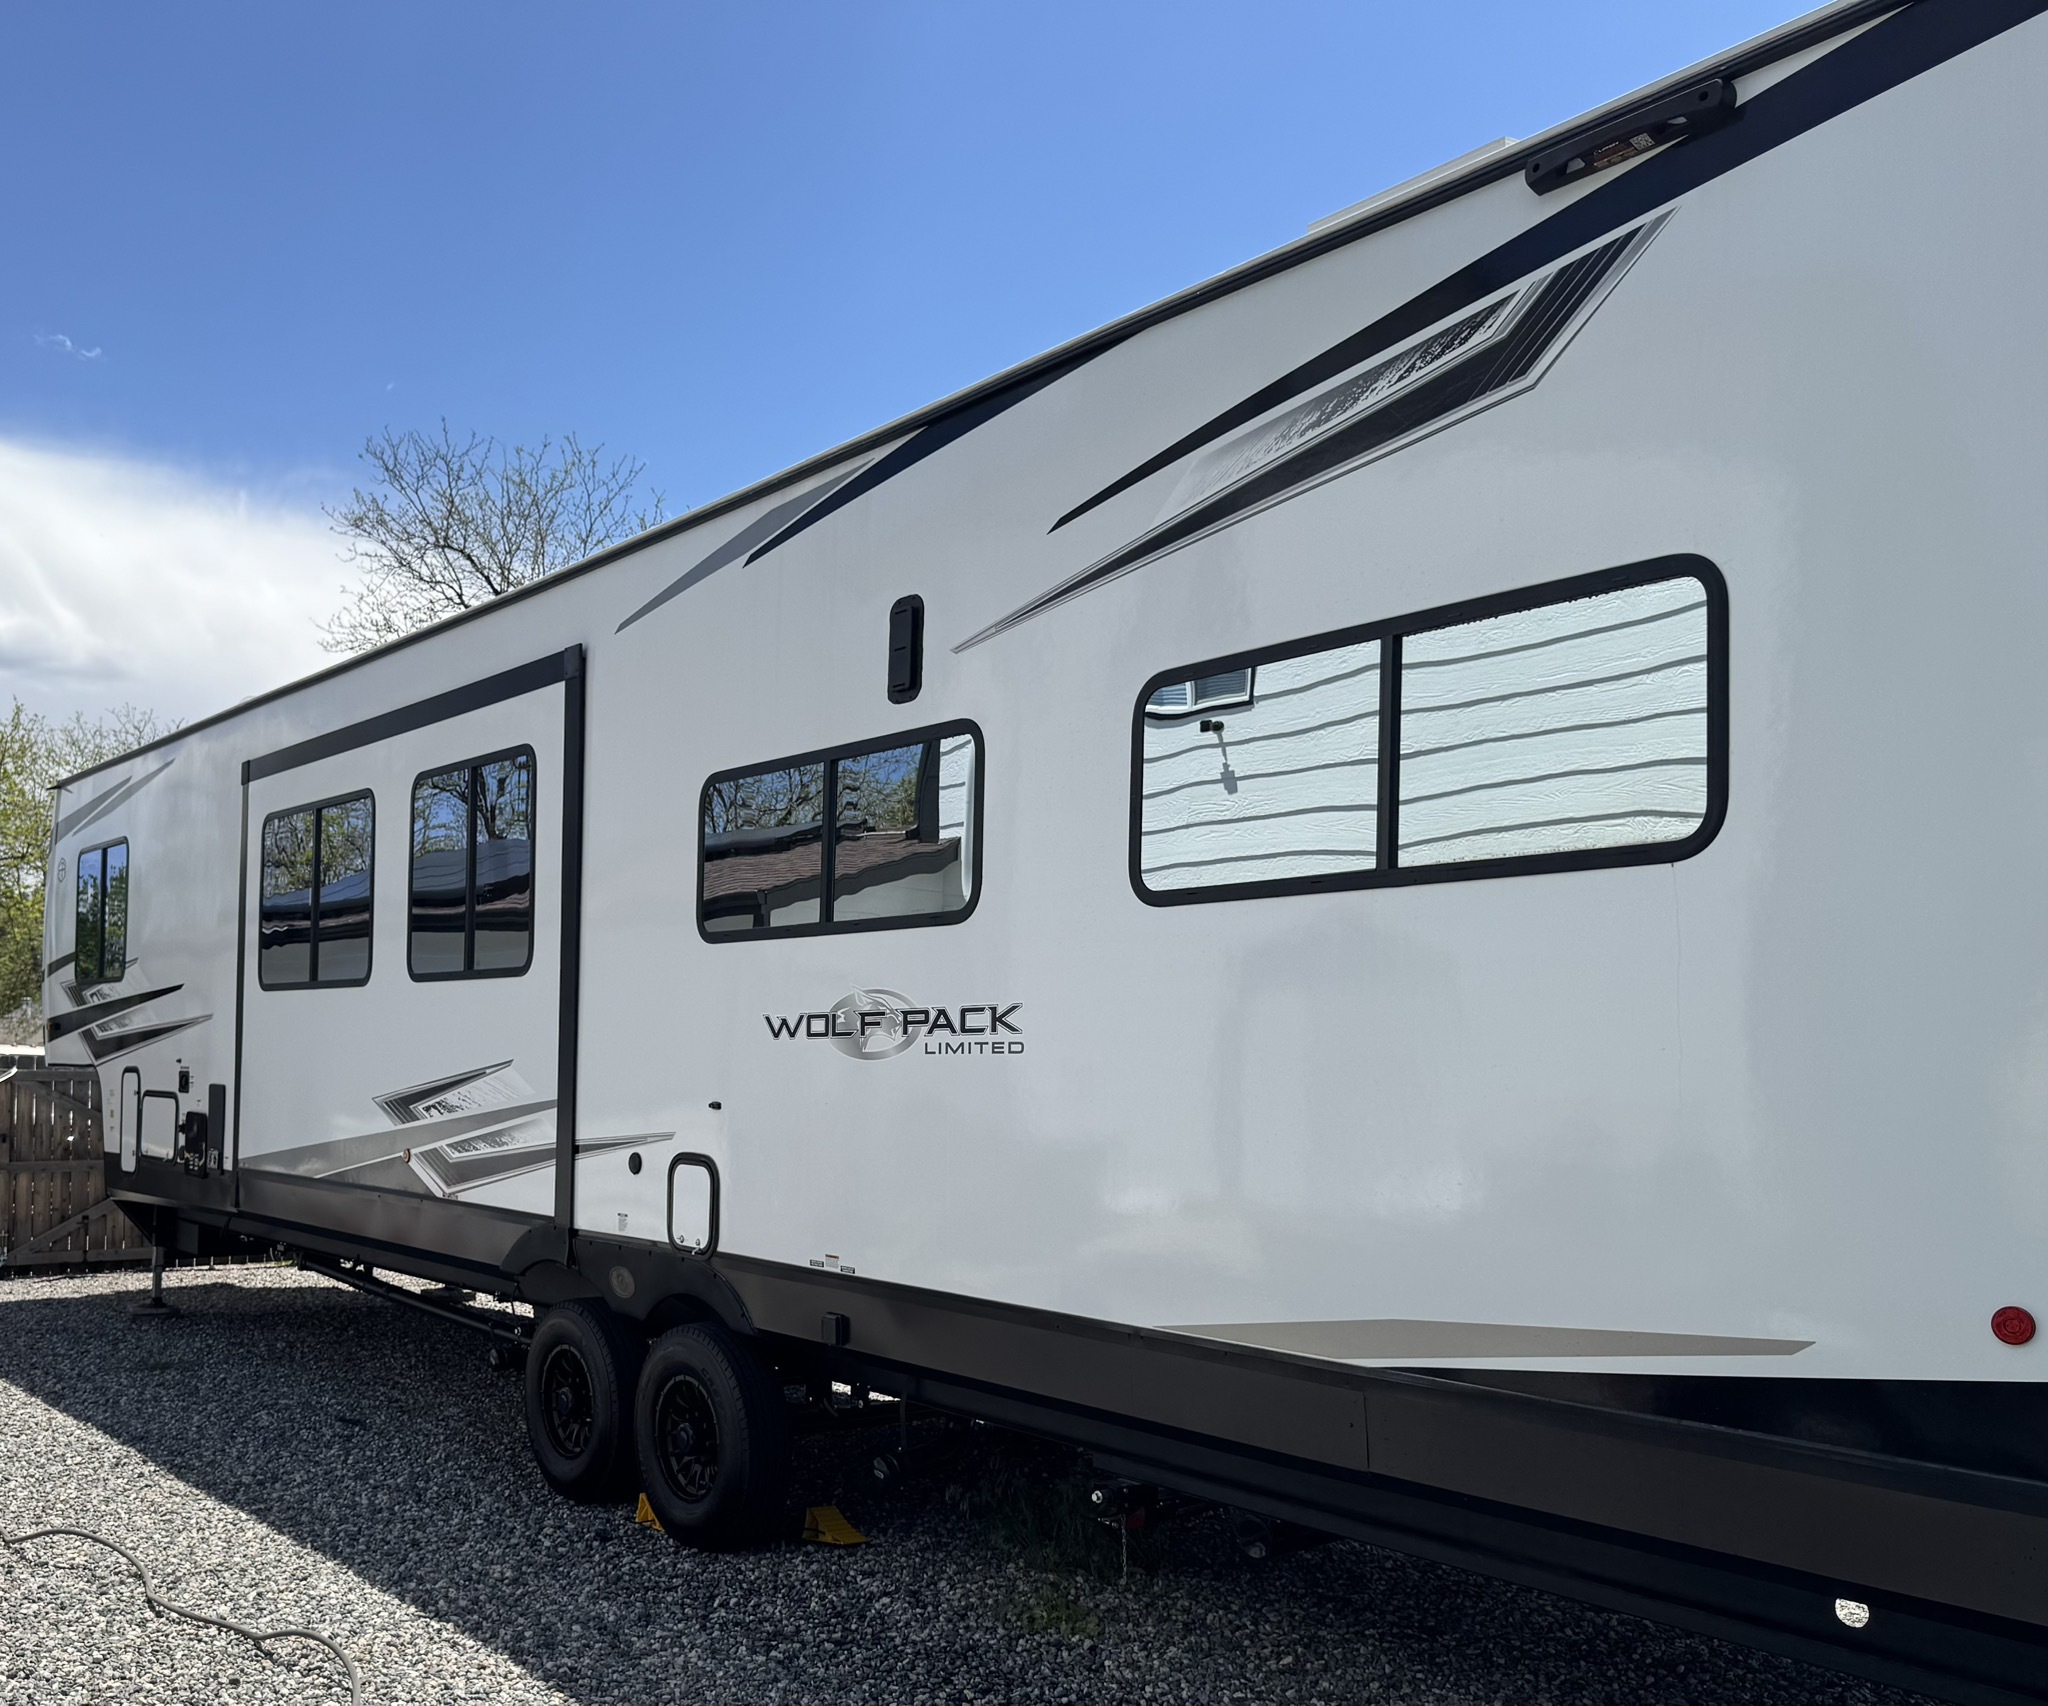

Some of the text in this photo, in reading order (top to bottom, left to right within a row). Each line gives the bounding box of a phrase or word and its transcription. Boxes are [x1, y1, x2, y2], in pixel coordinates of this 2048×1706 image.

[763, 1002, 1024, 1040] WOLF PACK
[924, 1041, 1025, 1055] LIMITED
